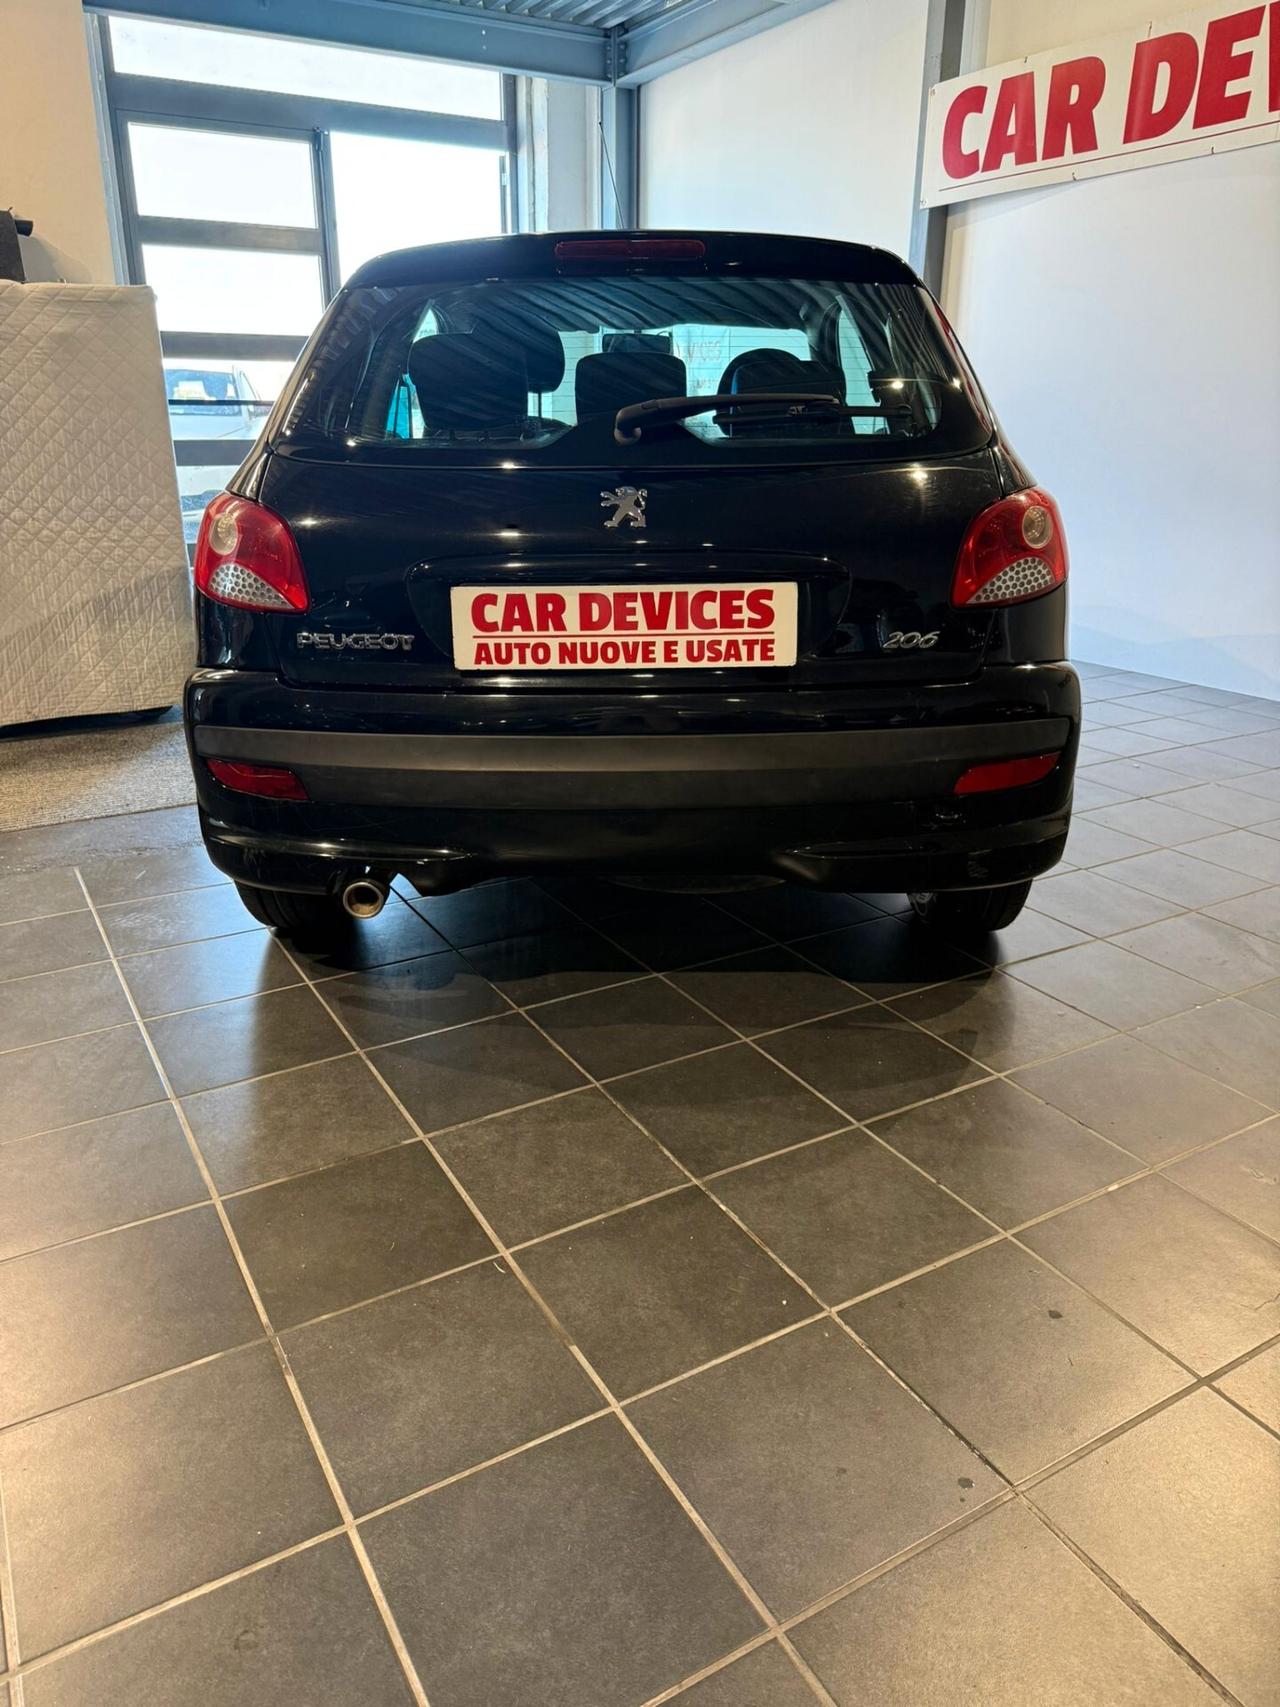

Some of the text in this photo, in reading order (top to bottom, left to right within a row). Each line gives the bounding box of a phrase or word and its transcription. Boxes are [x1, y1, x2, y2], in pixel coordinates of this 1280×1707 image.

[942, 0, 1280, 179] CAR DE
[471, 589, 775, 633] CAR DEVICES
[297, 632, 415, 651] PEUGEOT
[474, 638, 776, 665] AUTO NUOVE E USATE
[883, 631, 941, 649] 206
